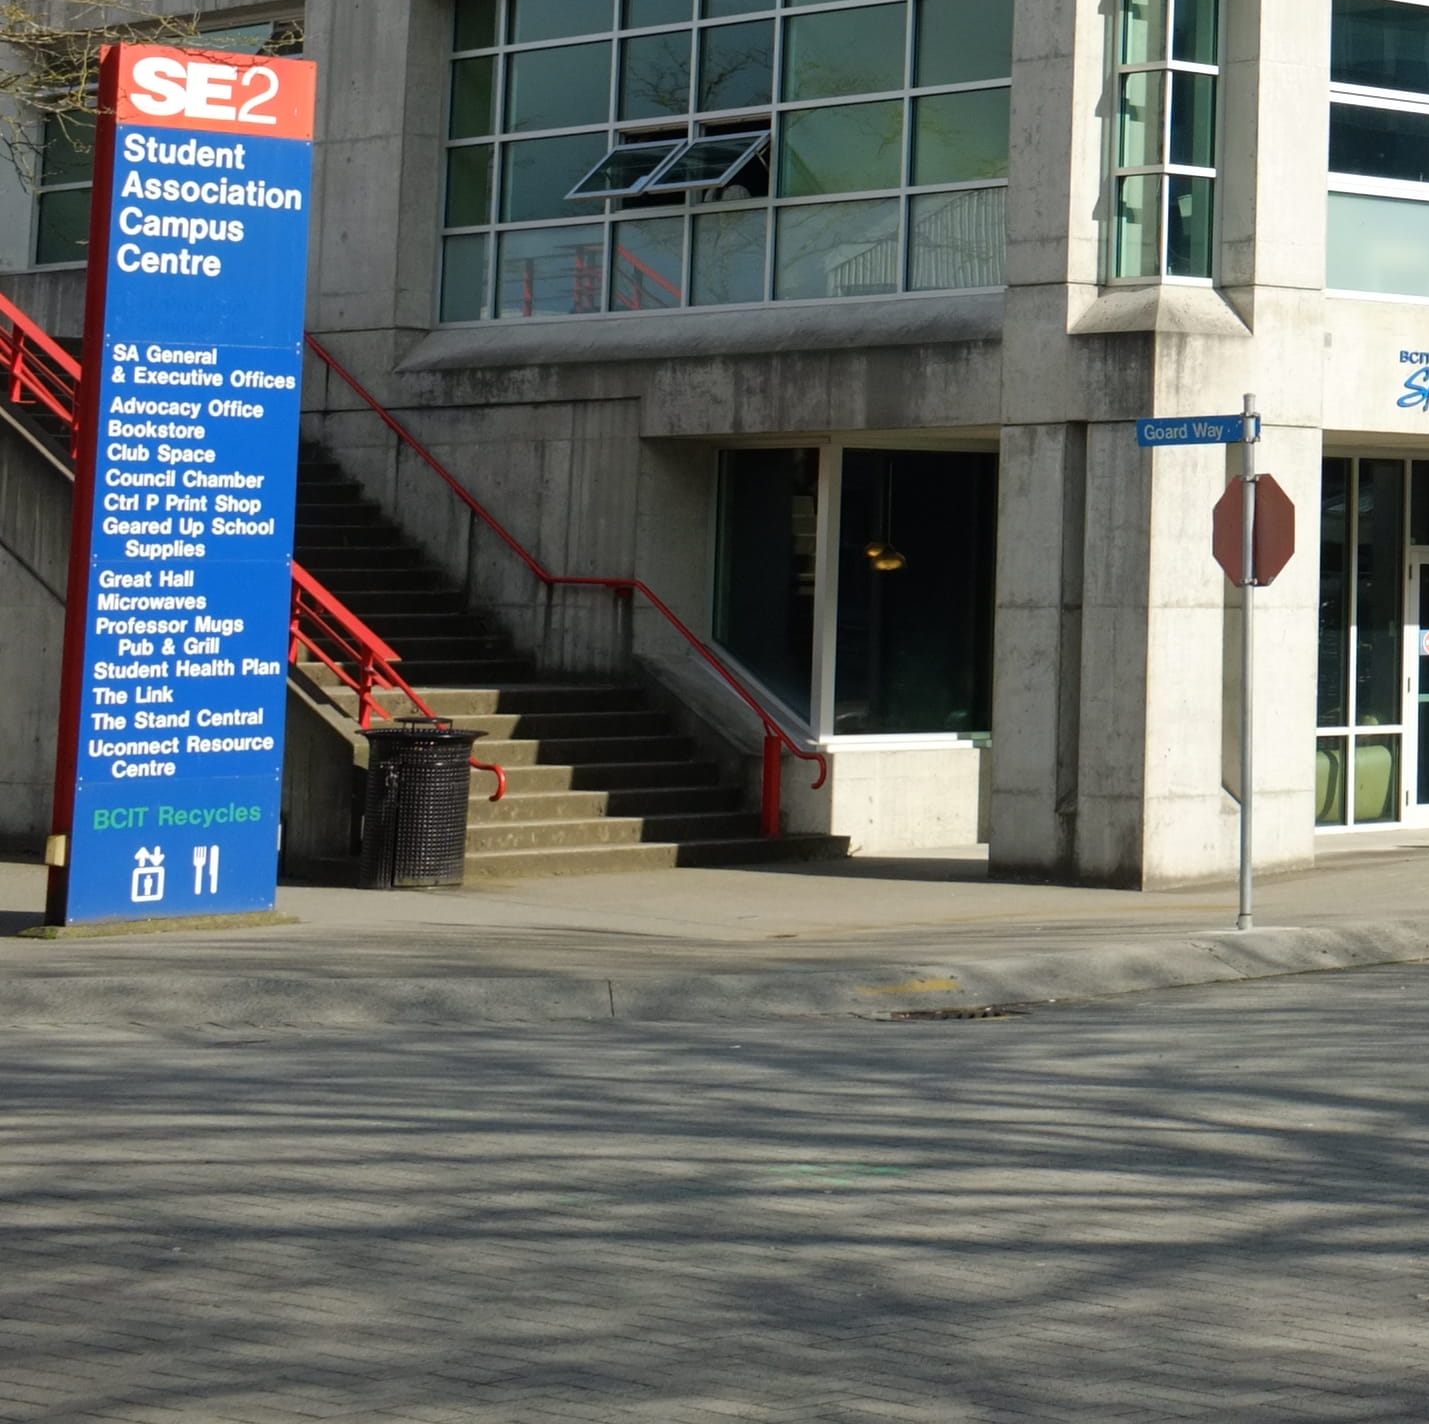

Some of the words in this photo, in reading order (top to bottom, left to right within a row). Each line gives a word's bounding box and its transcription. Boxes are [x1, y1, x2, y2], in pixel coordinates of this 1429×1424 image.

[131, 57, 279, 124] SE2
[124, 134, 245, 170] Student
[122, 171, 302, 211] Association
[120, 207, 244, 243] Campus
[117, 242, 221, 277] Centre
[113, 344, 139, 362] SA
[146, 345, 217, 365] General
[112, 366, 125, 383] &
[134, 366, 223, 386] Executive
[230, 370, 295, 389] Offices
[110, 396, 201, 421] Advocacy
[208, 399, 264, 418] Office
[108, 420, 205, 439] Bookstore
[1144, 424, 1188, 441] Goard
[1192, 422, 1224, 441] Way
[107, 443, 149, 461] Club
[157, 444, 216, 465] Space
[106, 468, 176, 487] Council
[183, 470, 264, 488] Chamber
[104, 493, 139, 511] Ctrl
[146, 494, 159, 510] P
[166, 494, 207, 511] Print
[215, 495, 261, 515] Shop
[103, 517, 172, 534] Geared
[179, 518, 204, 538] Up
[212, 517, 274, 535] School
[125, 539, 205, 560] Supplies
[99, 570, 152, 588] Great
[159, 570, 194, 587] Hall
[97, 593, 206, 611] Microwaves
[96, 617, 188, 634] Professor
[195, 617, 244, 636] Mugs
[118, 638, 154, 656] Pub
[162, 638, 175, 655] &
[184, 637, 220, 655] Grill
[94, 661, 168, 680] Student
[176, 659, 235, 677] Health
[242, 658, 280, 675] Plan
[93, 687, 128, 704] The
[136, 686, 173, 703] Link
[91, 713, 126, 730] The
[134, 710, 190, 729] Stand
[197, 708, 263, 727] Central
[89, 737, 179, 757] Uconnect
[187, 736, 274, 752] Resource
[112, 760, 176, 778] Centre
[94, 807, 150, 830] BCIT
[158, 804, 261, 826] Recycles
